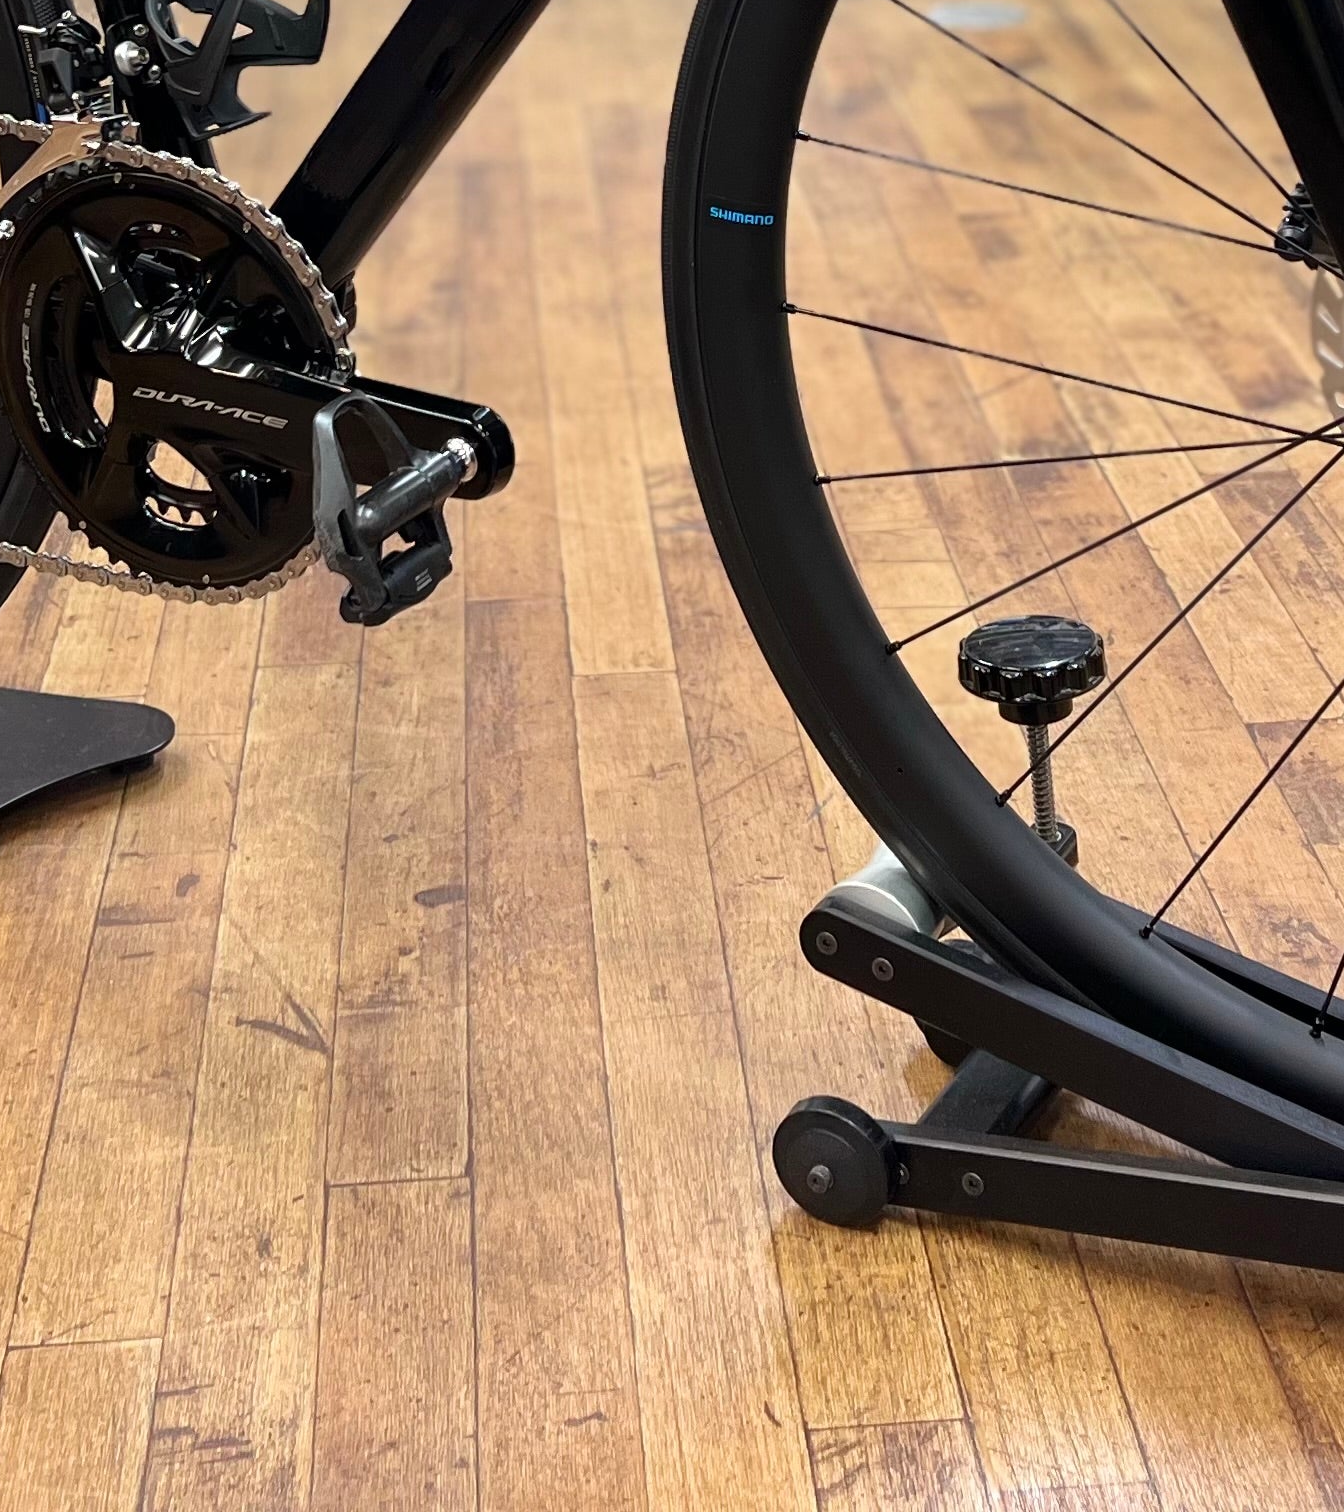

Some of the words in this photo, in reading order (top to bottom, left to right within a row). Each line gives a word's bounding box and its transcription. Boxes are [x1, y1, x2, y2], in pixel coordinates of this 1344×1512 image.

[709, 206, 775, 226] SHIMANO
[22, 322, 52, 433] DURA-ACE
[132, 386, 289, 430] DURA-ACE
